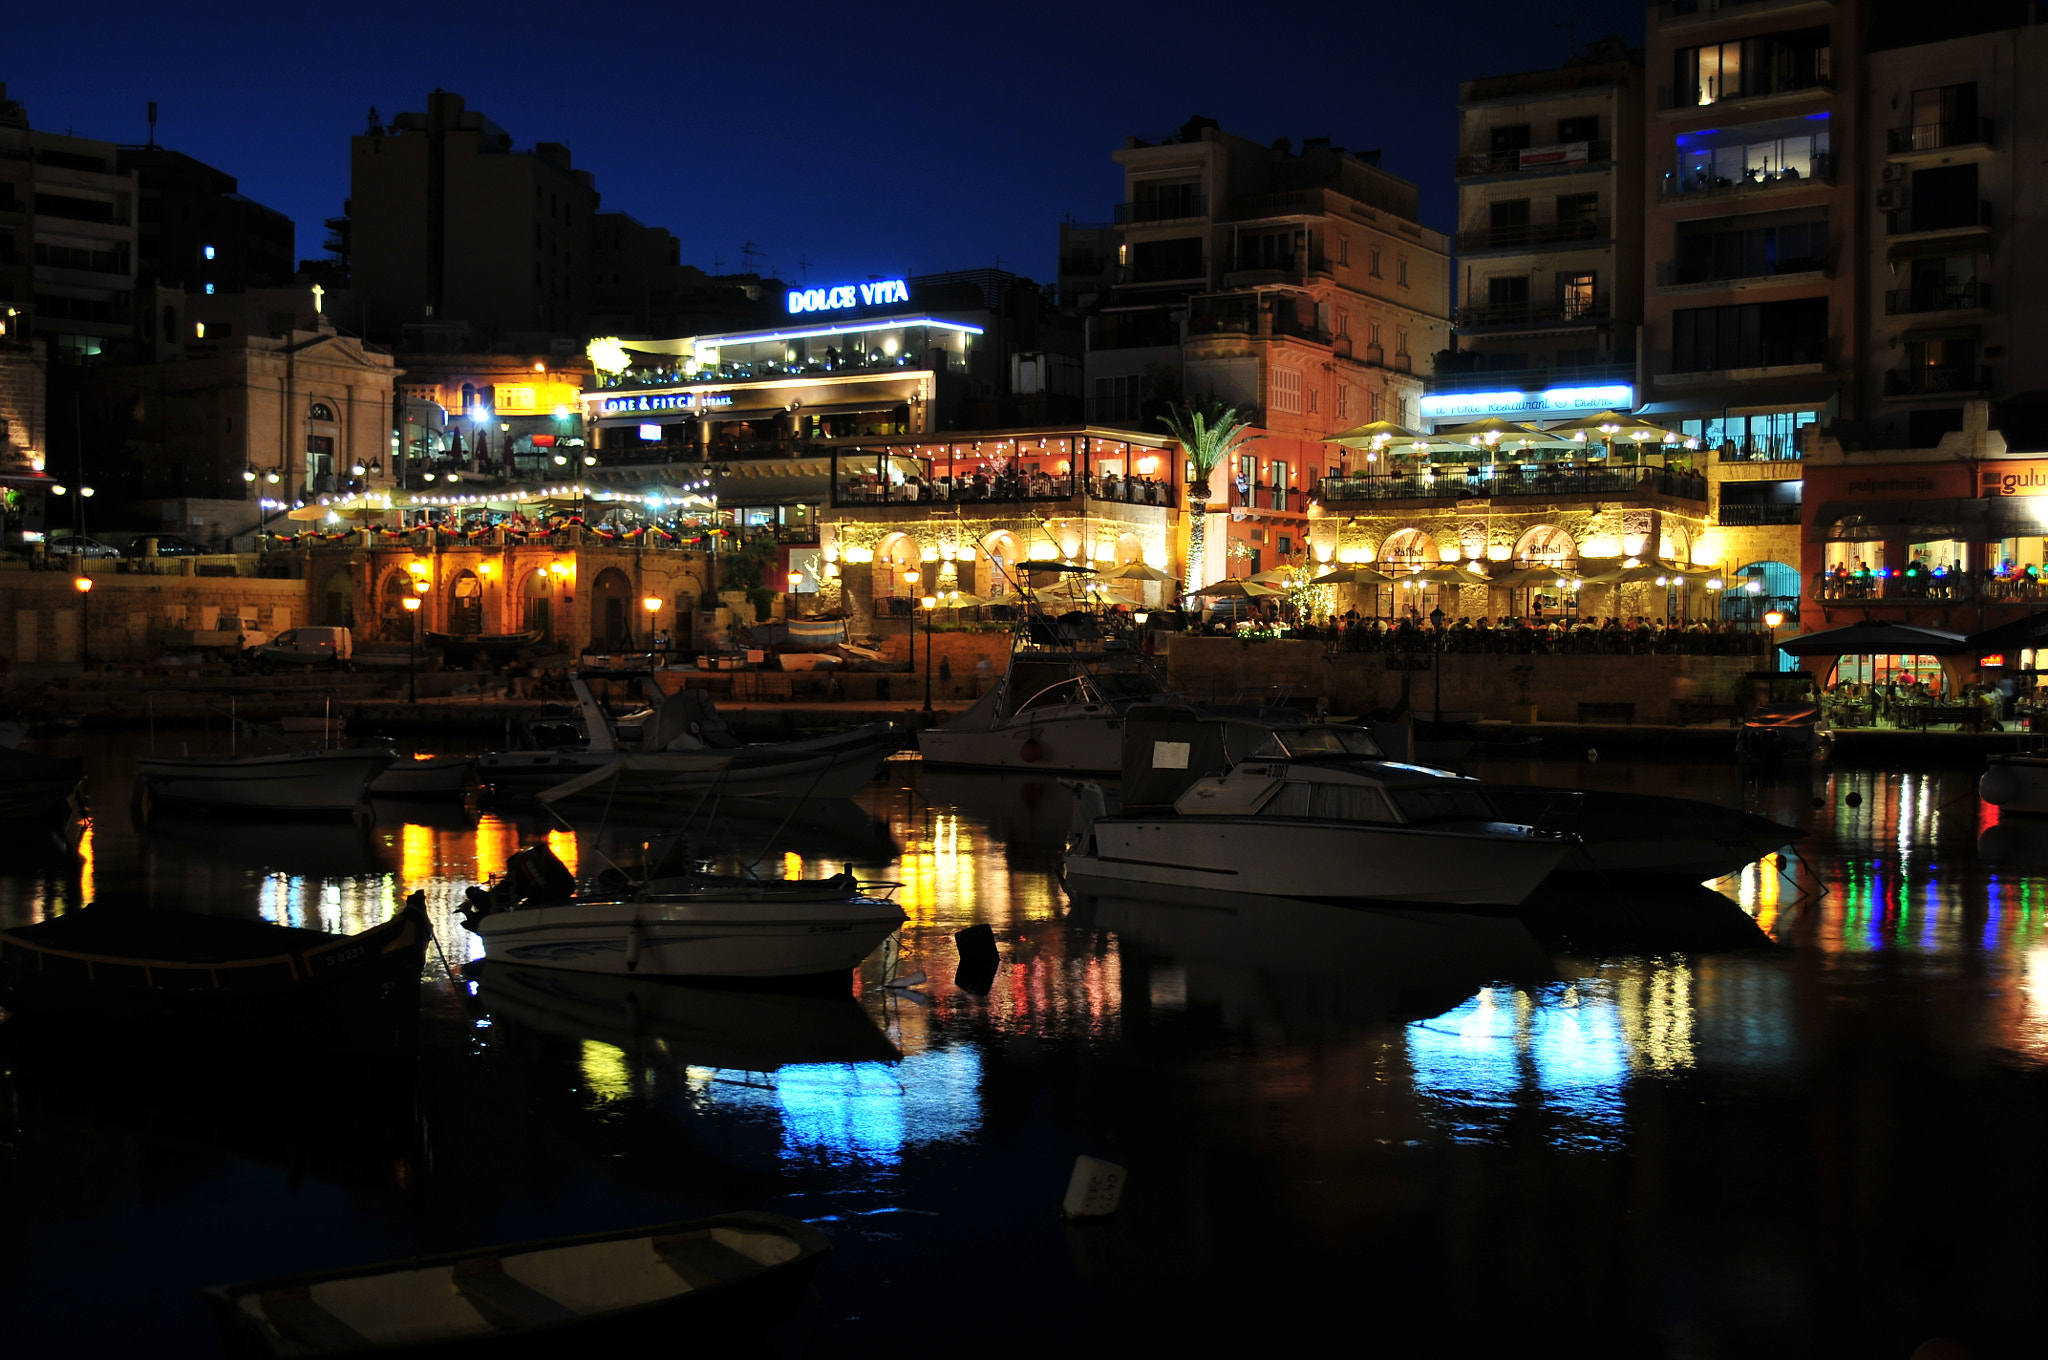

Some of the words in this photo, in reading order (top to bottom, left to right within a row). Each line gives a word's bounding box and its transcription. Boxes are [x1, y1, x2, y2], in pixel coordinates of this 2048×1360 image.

[788, 285, 857, 314] DOLCE
[859, 279, 909, 306] VITA
[600, 399, 636, 413] LORE
[639, 396, 650, 411] &
[653, 396, 696, 409] FITCH
